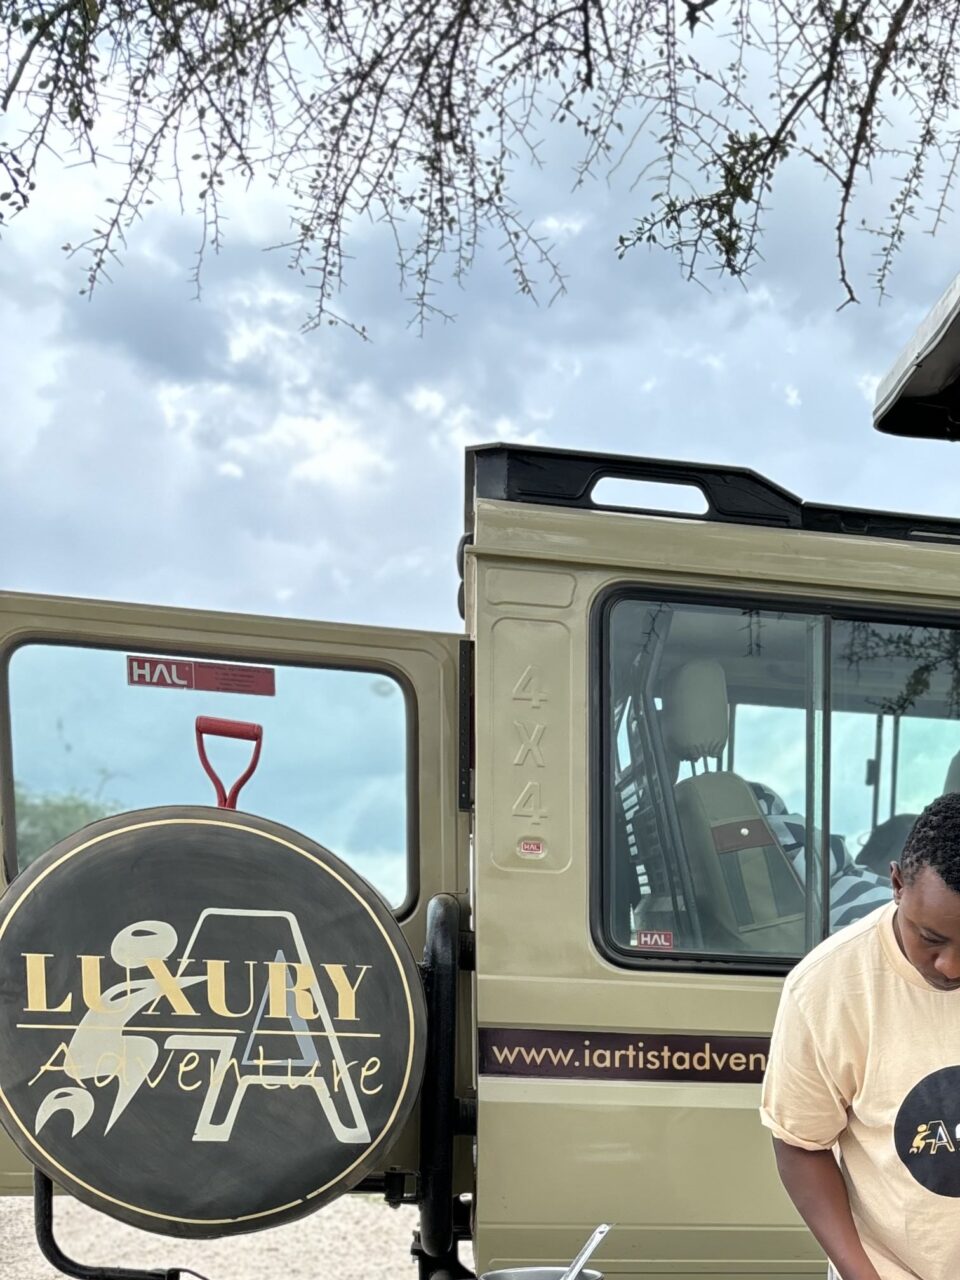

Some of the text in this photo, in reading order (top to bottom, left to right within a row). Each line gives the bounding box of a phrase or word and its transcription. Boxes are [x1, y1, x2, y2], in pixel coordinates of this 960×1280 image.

[132, 661, 188, 686] HAL
[640, 933, 670, 946] HAL
[20, 952, 373, 1021] LUXURY
[27, 1037, 384, 1095] Adventure
[491, 1039, 769, 1072] www.iartistadven
